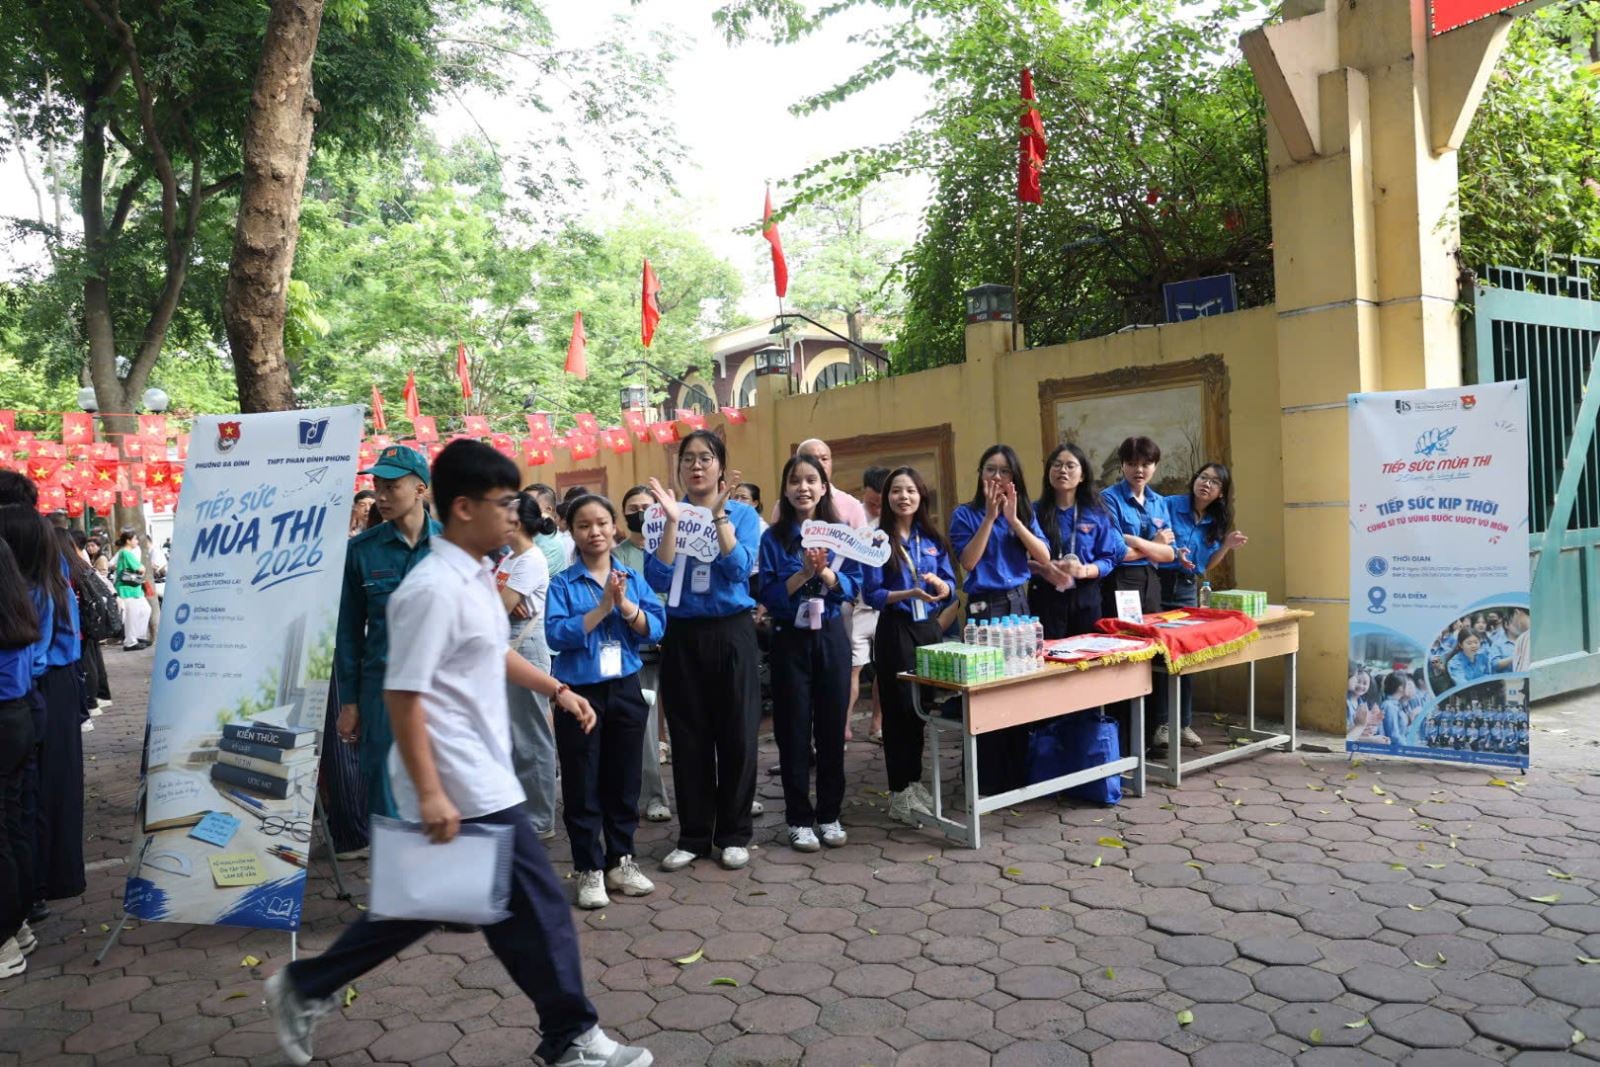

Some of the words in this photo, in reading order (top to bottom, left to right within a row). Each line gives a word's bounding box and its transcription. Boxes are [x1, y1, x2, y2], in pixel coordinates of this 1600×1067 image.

[1382, 459, 1406, 474] TIẾP
[1408, 458, 1435, 472] SỨC
[1437, 456, 1469, 471] MÙA
[1473, 454, 1492, 467] THI
[196, 488, 235, 523] TIẾP
[239, 484, 278, 514] SỨC
[1376, 496, 1404, 516] TIẾP
[1408, 495, 1434, 511] SỨC
[1465, 498, 1499, 516] THỜI
[190, 513, 260, 563] MÙA
[271, 503, 327, 549] THI
[678, 519, 702, 536] RỘP
[251, 537, 323, 585] 2026
[236, 728, 255, 740] KIẾN
[256, 731, 280, 744] THỨC
